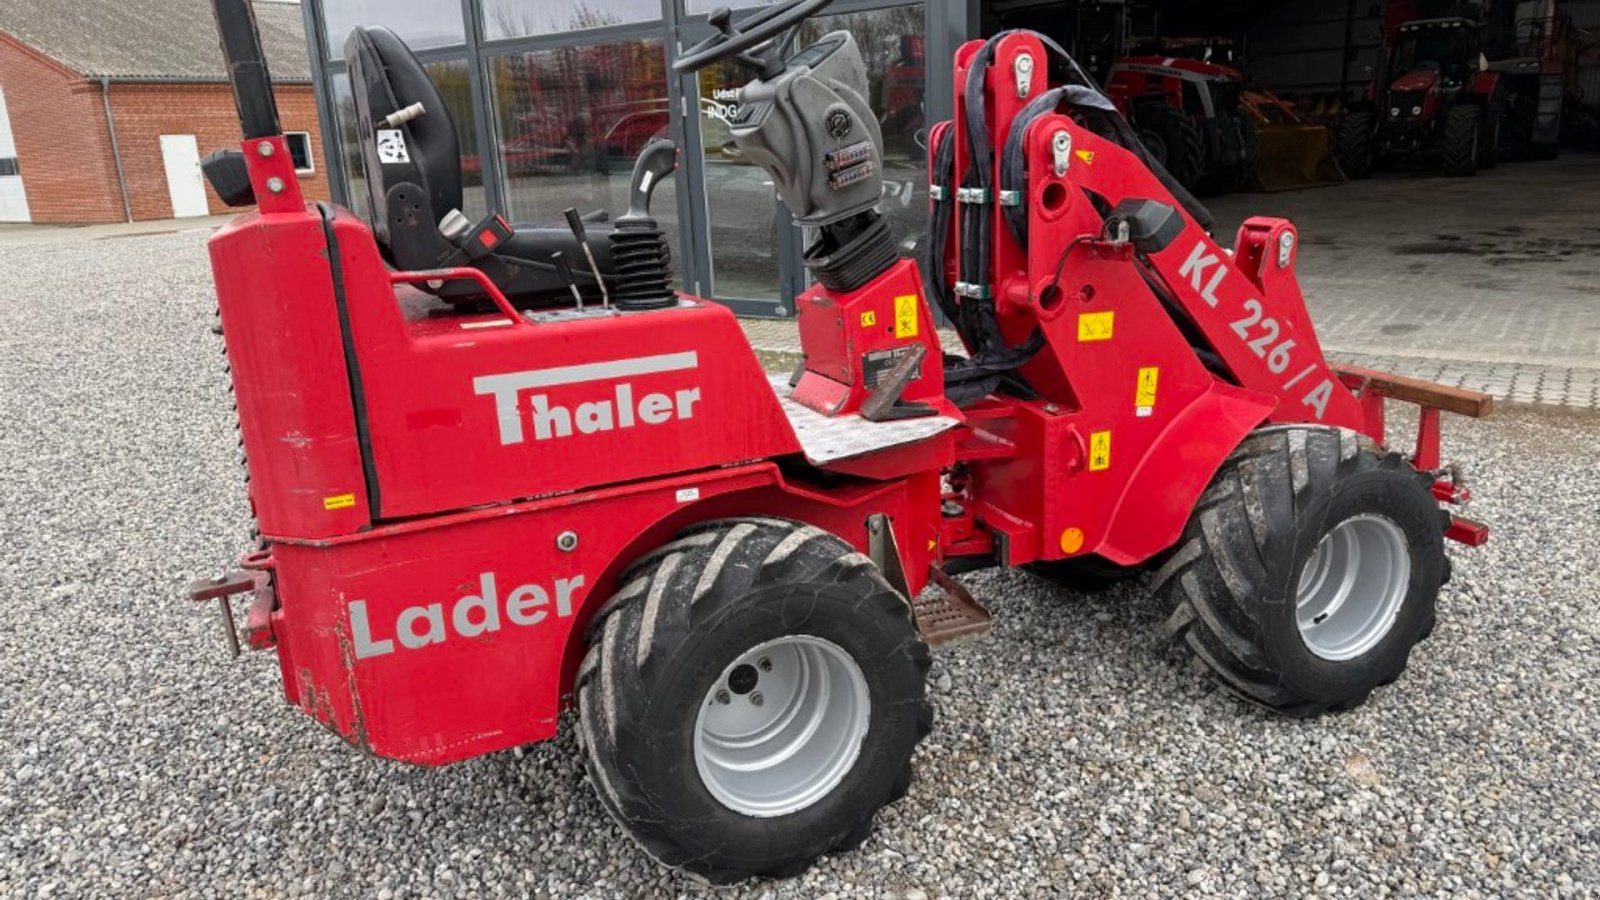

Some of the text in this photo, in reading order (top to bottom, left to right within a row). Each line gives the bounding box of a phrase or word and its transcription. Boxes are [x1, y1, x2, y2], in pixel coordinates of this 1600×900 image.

[707, 104, 740, 119] INDG
[1178, 240, 1228, 308] KL
[472, 350, 700, 445] Thaler
[347, 571, 585, 660] Lader
